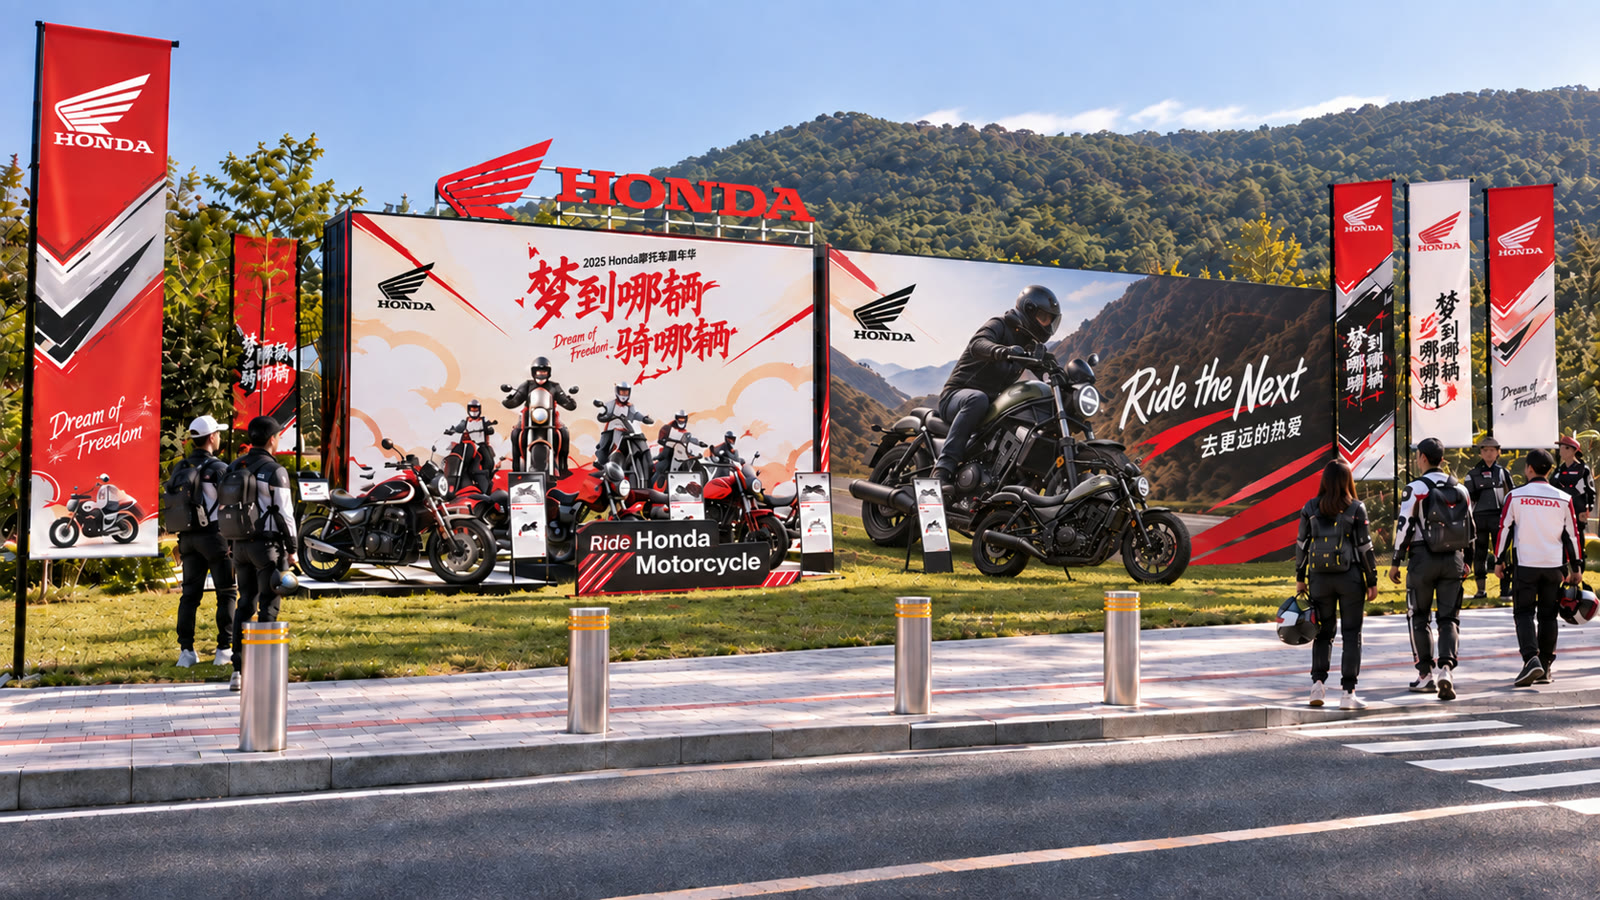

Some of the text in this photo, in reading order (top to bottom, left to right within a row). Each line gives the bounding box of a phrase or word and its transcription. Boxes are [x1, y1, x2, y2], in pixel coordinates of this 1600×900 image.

[53, 131, 154, 154] HONDA
[556, 166, 816, 222] HONDA
[1344, 224, 1384, 233] HONDA
[1417, 242, 1462, 252] HONDA
[1498, 247, 1544, 257] HONDA
[583, 257, 606, 268] 2025
[376, 299, 436, 311] HONDA
[552, 326, 598, 350] Dream of
[853, 330, 916, 342] HONDA
[570, 339, 609, 362] Freedom
[1118, 354, 1308, 431] Ride the Next
[1501, 378, 1538, 401] Dream of
[49, 396, 126, 440] Dream of
[75, 424, 143, 460] Freedom
[1201, 415, 1303, 459] 去更远的热爱
[1520, 498, 1561, 508] HONDA
[590, 529, 711, 551] Ride Honda
[636, 552, 761, 575] Motorcycle
